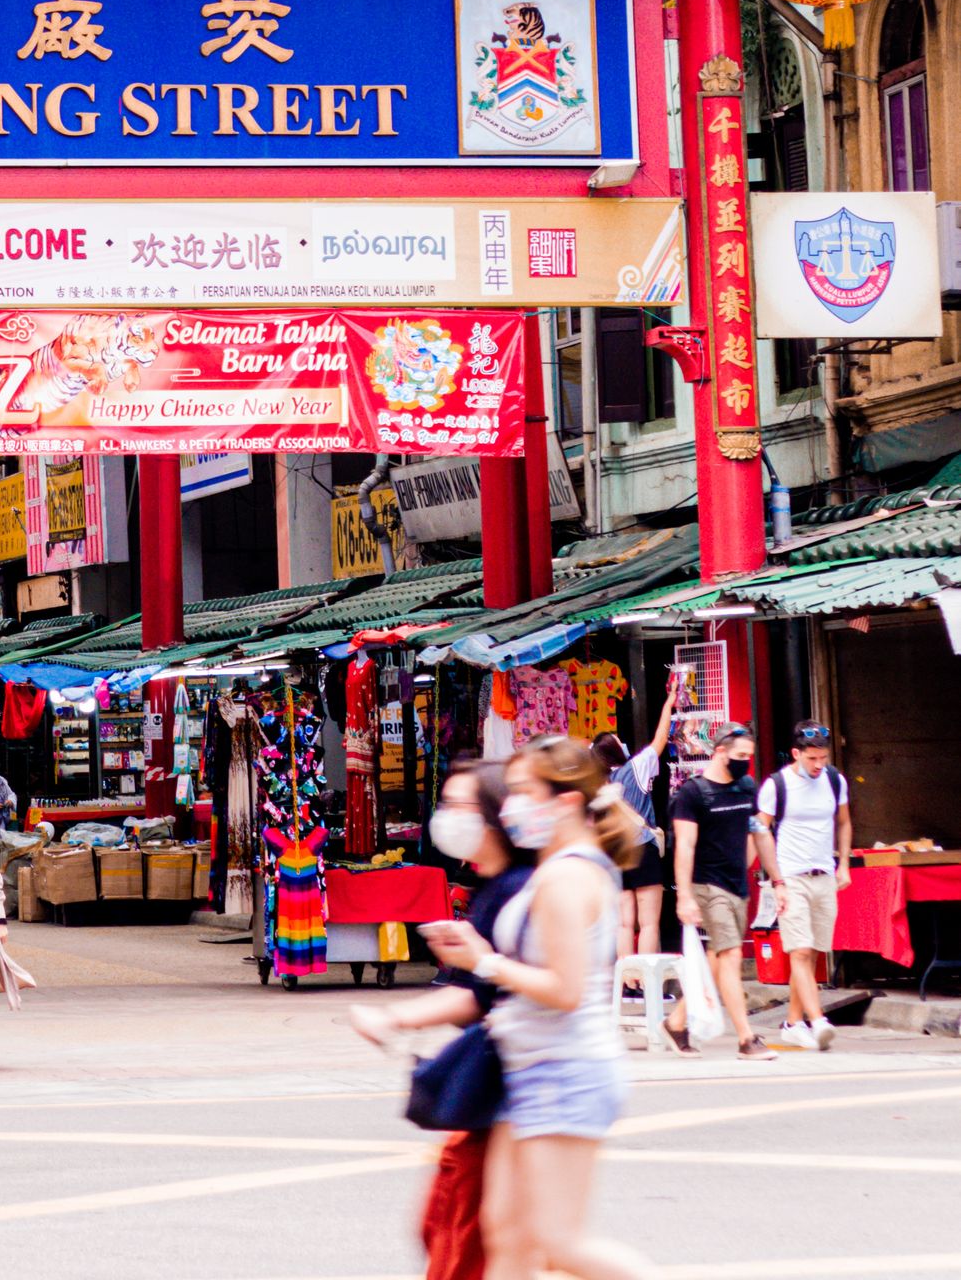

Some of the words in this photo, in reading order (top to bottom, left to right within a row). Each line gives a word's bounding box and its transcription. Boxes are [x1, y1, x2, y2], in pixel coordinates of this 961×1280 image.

[121, 82, 407, 136] STREET
[131, 231, 283, 271] 欢迎光临
[321, 229, 447, 263] நல்வரவு
[482, 214, 509, 292] 丙申年
[202, 285, 251, 297] PERSATUAN
[253, 285, 290, 297] PENJAJA
[291, 285, 309, 297] DAN
[310, 285, 346, 297] PENIAGA
[348, 285, 372, 297] KECIL
[373, 285, 400, 297] KUALA
[401, 284, 436, 297] LUMPUR
[163, 320, 267, 346] Selamat
[274, 320, 347, 344] Tahun
[222, 348, 284, 373] Baru
[290, 347, 348, 372] Cina
[461, 379, 505, 394] LOONG
[89, 397, 155, 421] Happy
[160, 398, 235, 417] Chinese
[242, 398, 285, 417] New
[290, 396, 332, 416] Year
[465, 395, 500, 409] KEE
[99, 439, 120, 451] K.L.
[121, 438, 176, 451] HAWKERS'
[179, 438, 187, 450] &
[189, 438, 224, 450] PETTY
[225, 437, 274, 450] TRADES'
[279, 436, 349, 449] ASSOCIATION
[378, 428, 400, 445] Try
[450, 431, 477, 443] Love
